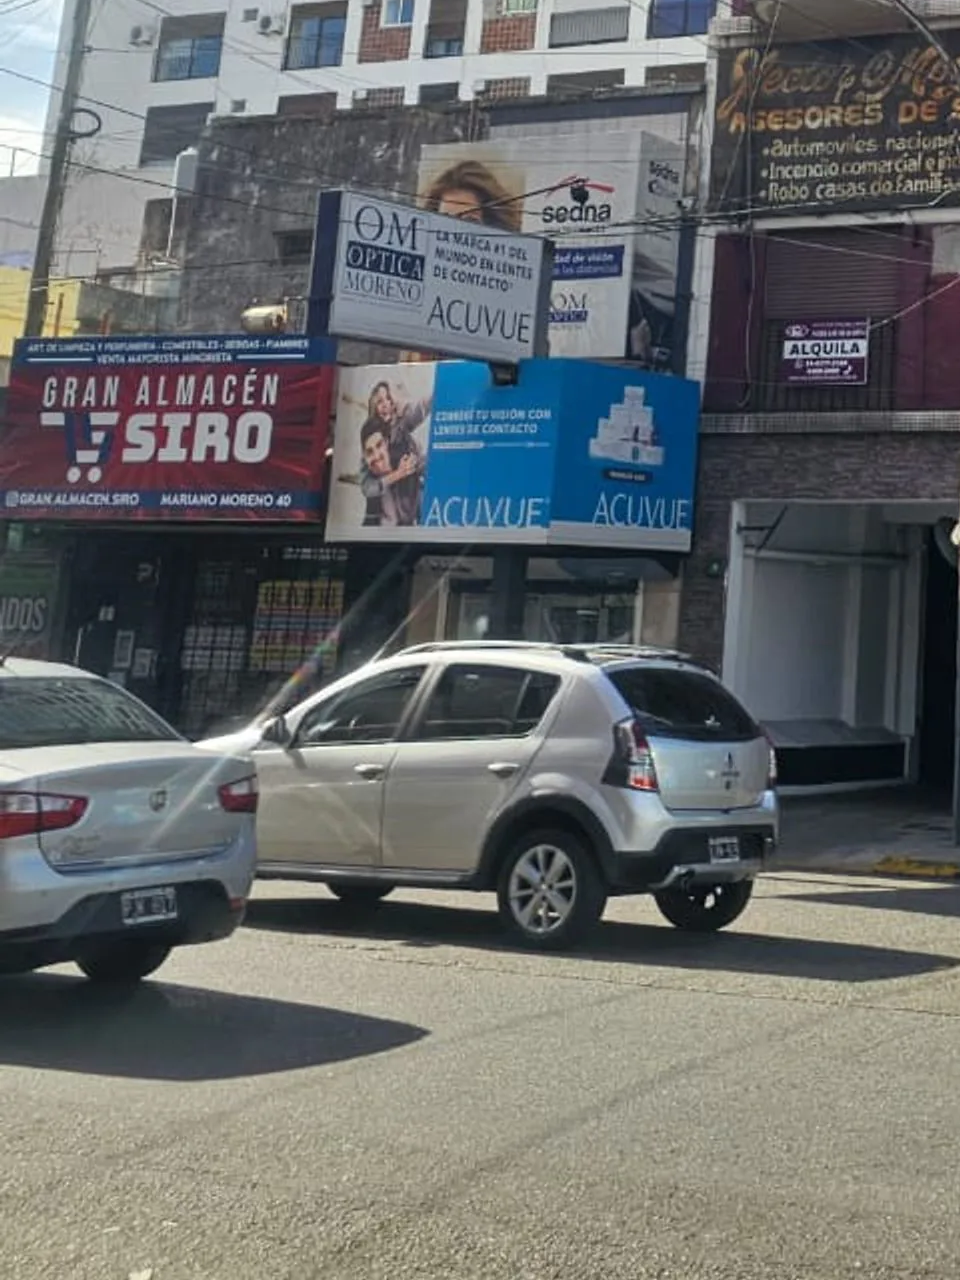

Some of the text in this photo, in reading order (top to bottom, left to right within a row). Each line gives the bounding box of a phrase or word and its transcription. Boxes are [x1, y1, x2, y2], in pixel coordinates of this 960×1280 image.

[729, 103, 884, 132] ASESORES
[898, 99, 939, 124] DE
[769, 160, 839, 180] Incendio
[841, 152, 923, 175] comercial
[768, 182, 808, 201] Robo
[815, 180, 867, 200] casas
[870, 176, 894, 199] de
[354, 205, 418, 251] OM
[542, 202, 611, 223] sedna
[436, 231, 450, 243] LA
[453, 233, 491, 253] MARCA
[509, 246, 528, 262] DEL
[348, 246, 424, 280] OPTICA
[433, 264, 449, 280] DE
[434, 247, 533, 281] MUNDO EN LENTES
[344, 271, 422, 302] MORENO
[427, 295, 531, 344] ACUVUE
[97, 353, 126, 366] VENTA
[128, 353, 179, 365] MAYORISTA
[789, 341, 860, 357] ALQUILA
[43, 368, 280, 407] GRAN ALMACÉN
[121, 411, 274, 463] SIRO
[481, 422, 539, 435] CONTACTO
[160, 493, 217, 507] MARIANO
[219, 493, 273, 508] MORENO
[276, 494, 292, 508] 40
[426, 496, 547, 529] ACUVUE
[592, 491, 690, 530] ACUVUE
